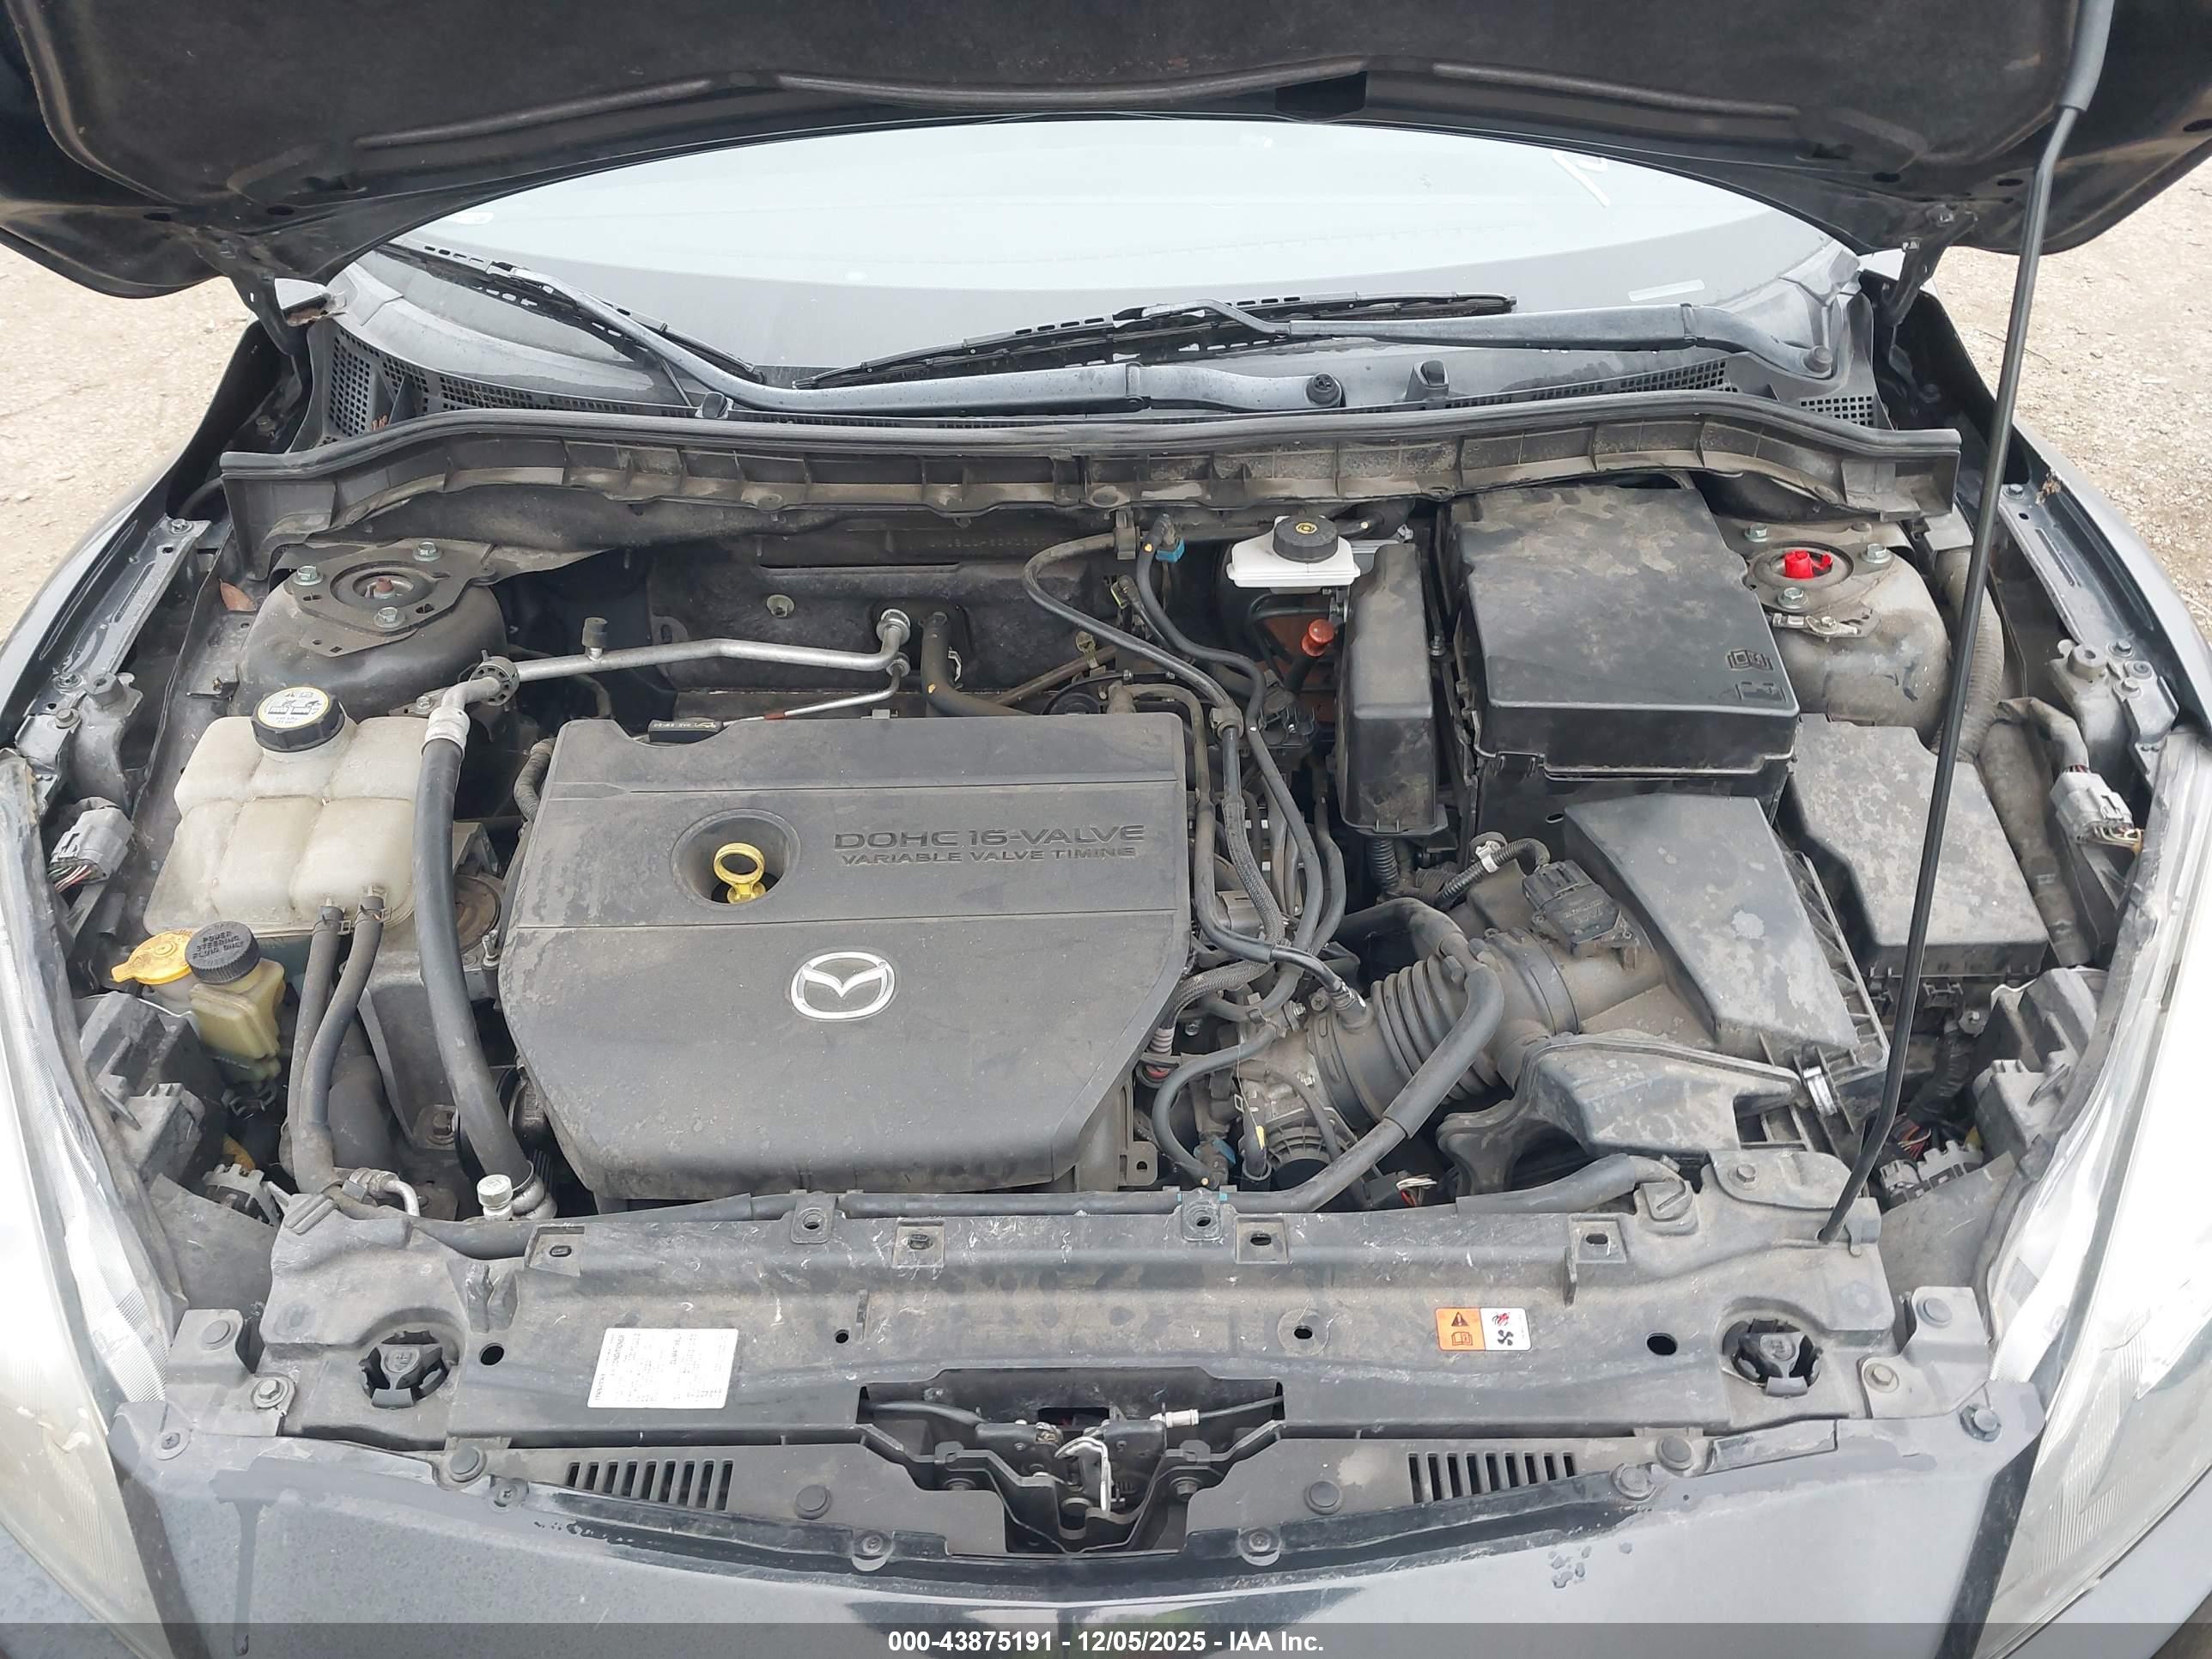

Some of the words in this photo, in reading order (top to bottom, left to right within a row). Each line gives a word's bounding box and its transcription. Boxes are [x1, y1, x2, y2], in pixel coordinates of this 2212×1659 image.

[834, 830, 959, 850] DOHC
[969, 824, 1146, 848] 16-VALVE
[842, 851, 963, 866] VARIABLE
[969, 849, 1045, 862] VALVE
[1050, 847, 1137, 860] TIMING
